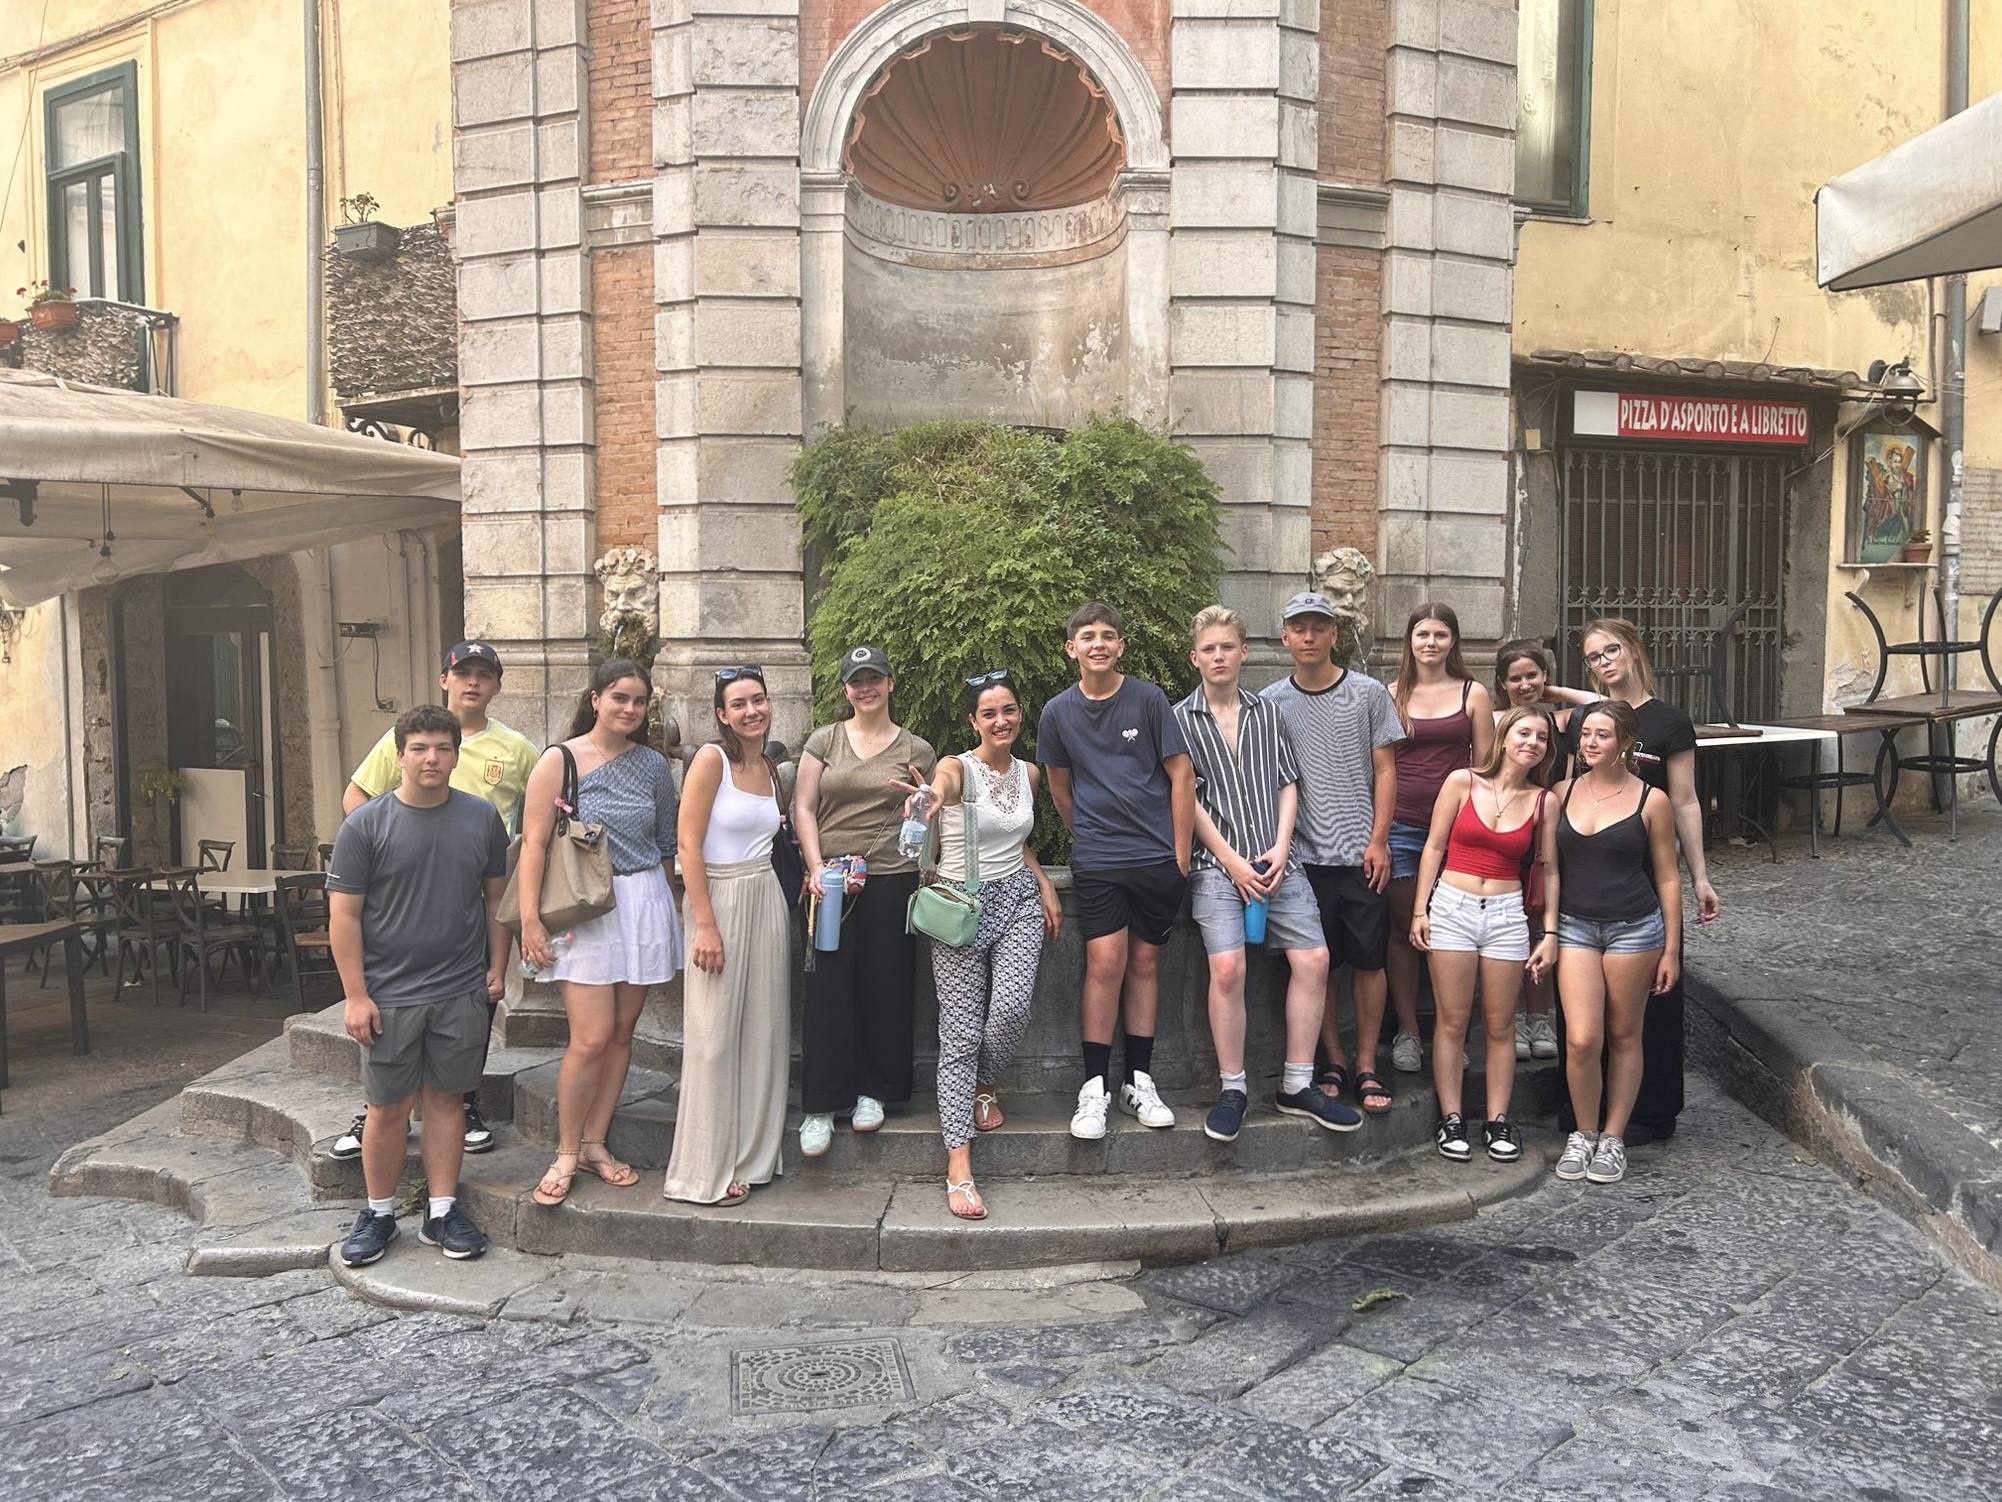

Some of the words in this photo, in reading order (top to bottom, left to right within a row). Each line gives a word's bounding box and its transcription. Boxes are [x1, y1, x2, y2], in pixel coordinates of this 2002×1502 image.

[1621, 399, 1657, 431] PIZZA
[1659, 400, 1728, 433] D'ASPORTO
[1731, 404, 1738, 434] E
[1740, 406, 1750, 434] A
[1752, 406, 1807, 436] LIBRETTO
